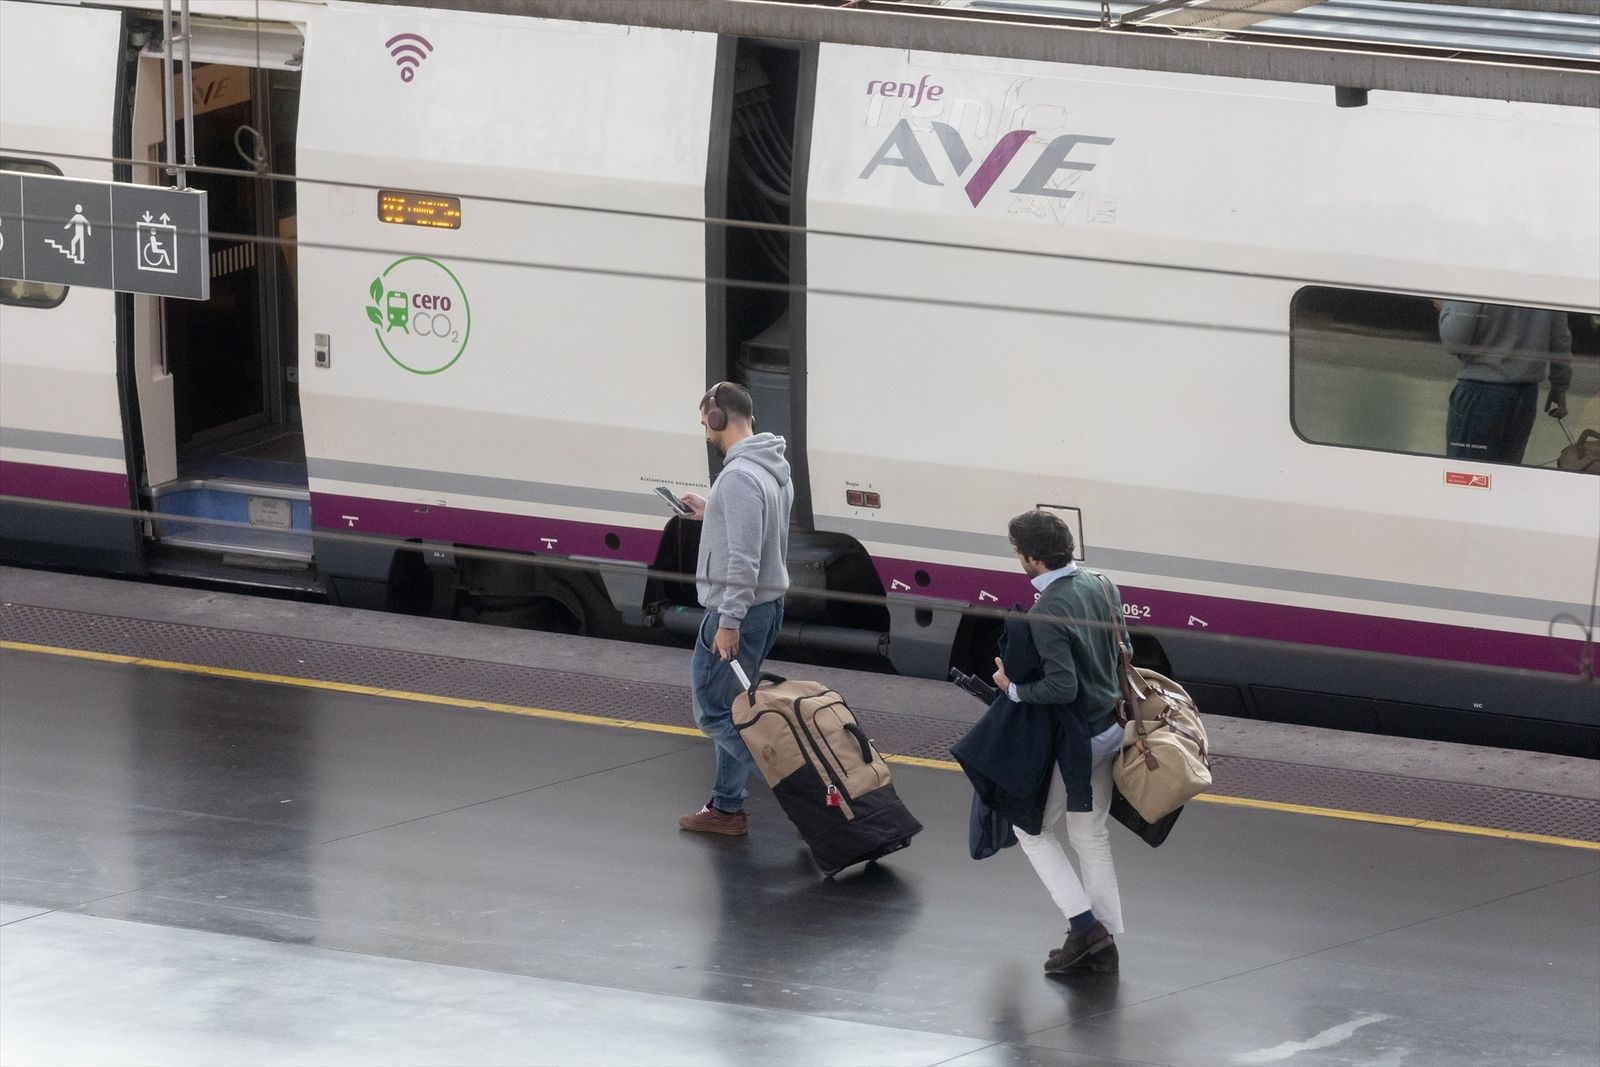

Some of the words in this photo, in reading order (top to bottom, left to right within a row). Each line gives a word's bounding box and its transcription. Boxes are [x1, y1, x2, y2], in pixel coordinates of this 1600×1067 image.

[866, 74, 944, 108] renfe
[858, 118, 1116, 208] AVE
[412, 293, 452, 311] cero
